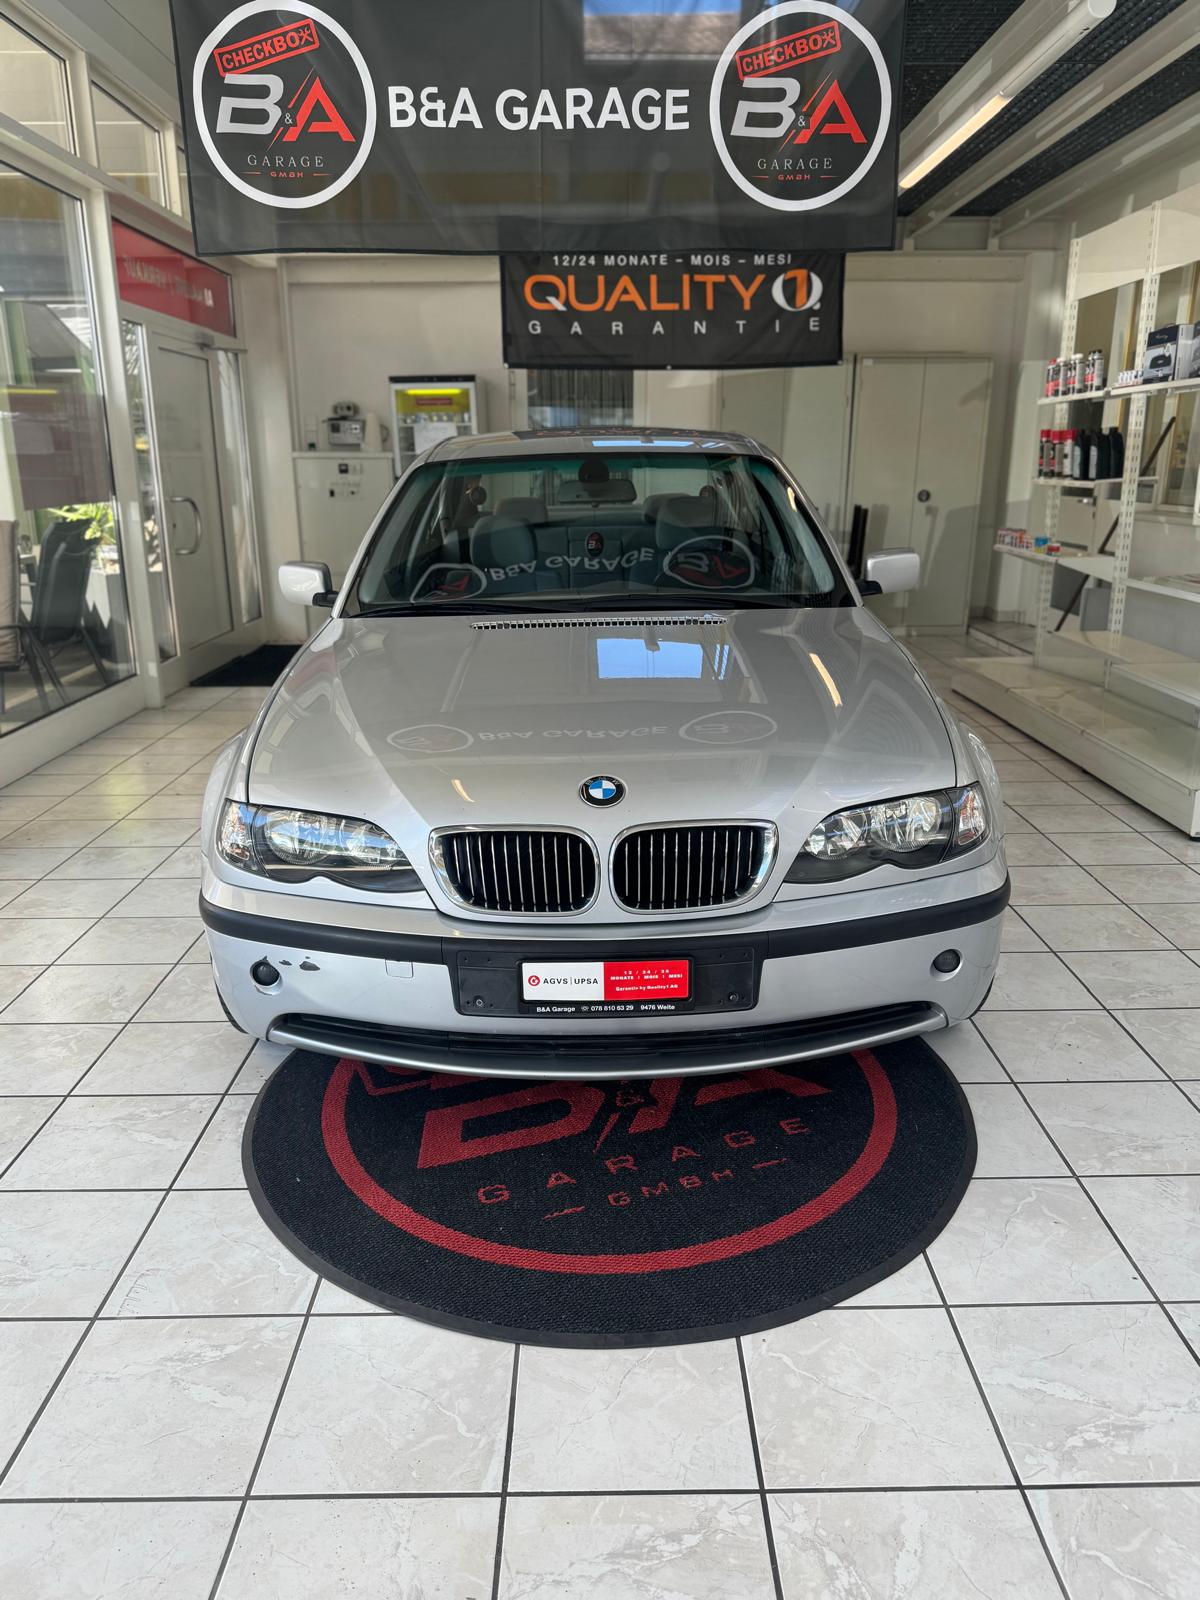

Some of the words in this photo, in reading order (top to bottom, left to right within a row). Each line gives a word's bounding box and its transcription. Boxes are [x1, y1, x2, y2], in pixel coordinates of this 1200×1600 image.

[221, 26, 314, 69] CHECKBOX
[742, 30, 836, 72] CHECKBOX
[387, 86, 484, 129] B&A
[495, 86, 690, 131] GARAGE
[247, 154, 325, 168] GARAGE
[757, 157, 833, 171] GARAGE
[553, 255, 596, 266] 12/24
[604, 254, 668, 266] MONATE
[691, 254, 731, 266] MOIS
[754, 253, 793, 266] MESI
[523, 273, 766, 311] QUALITY
[528, 317, 820, 335] GARANTIE
[543, 978, 568, 986] AGVS
[574, 977, 598, 986] UPSA
[478, 1117, 811, 1205] GARAGE
[607, 1168, 736, 1207] GMBH
